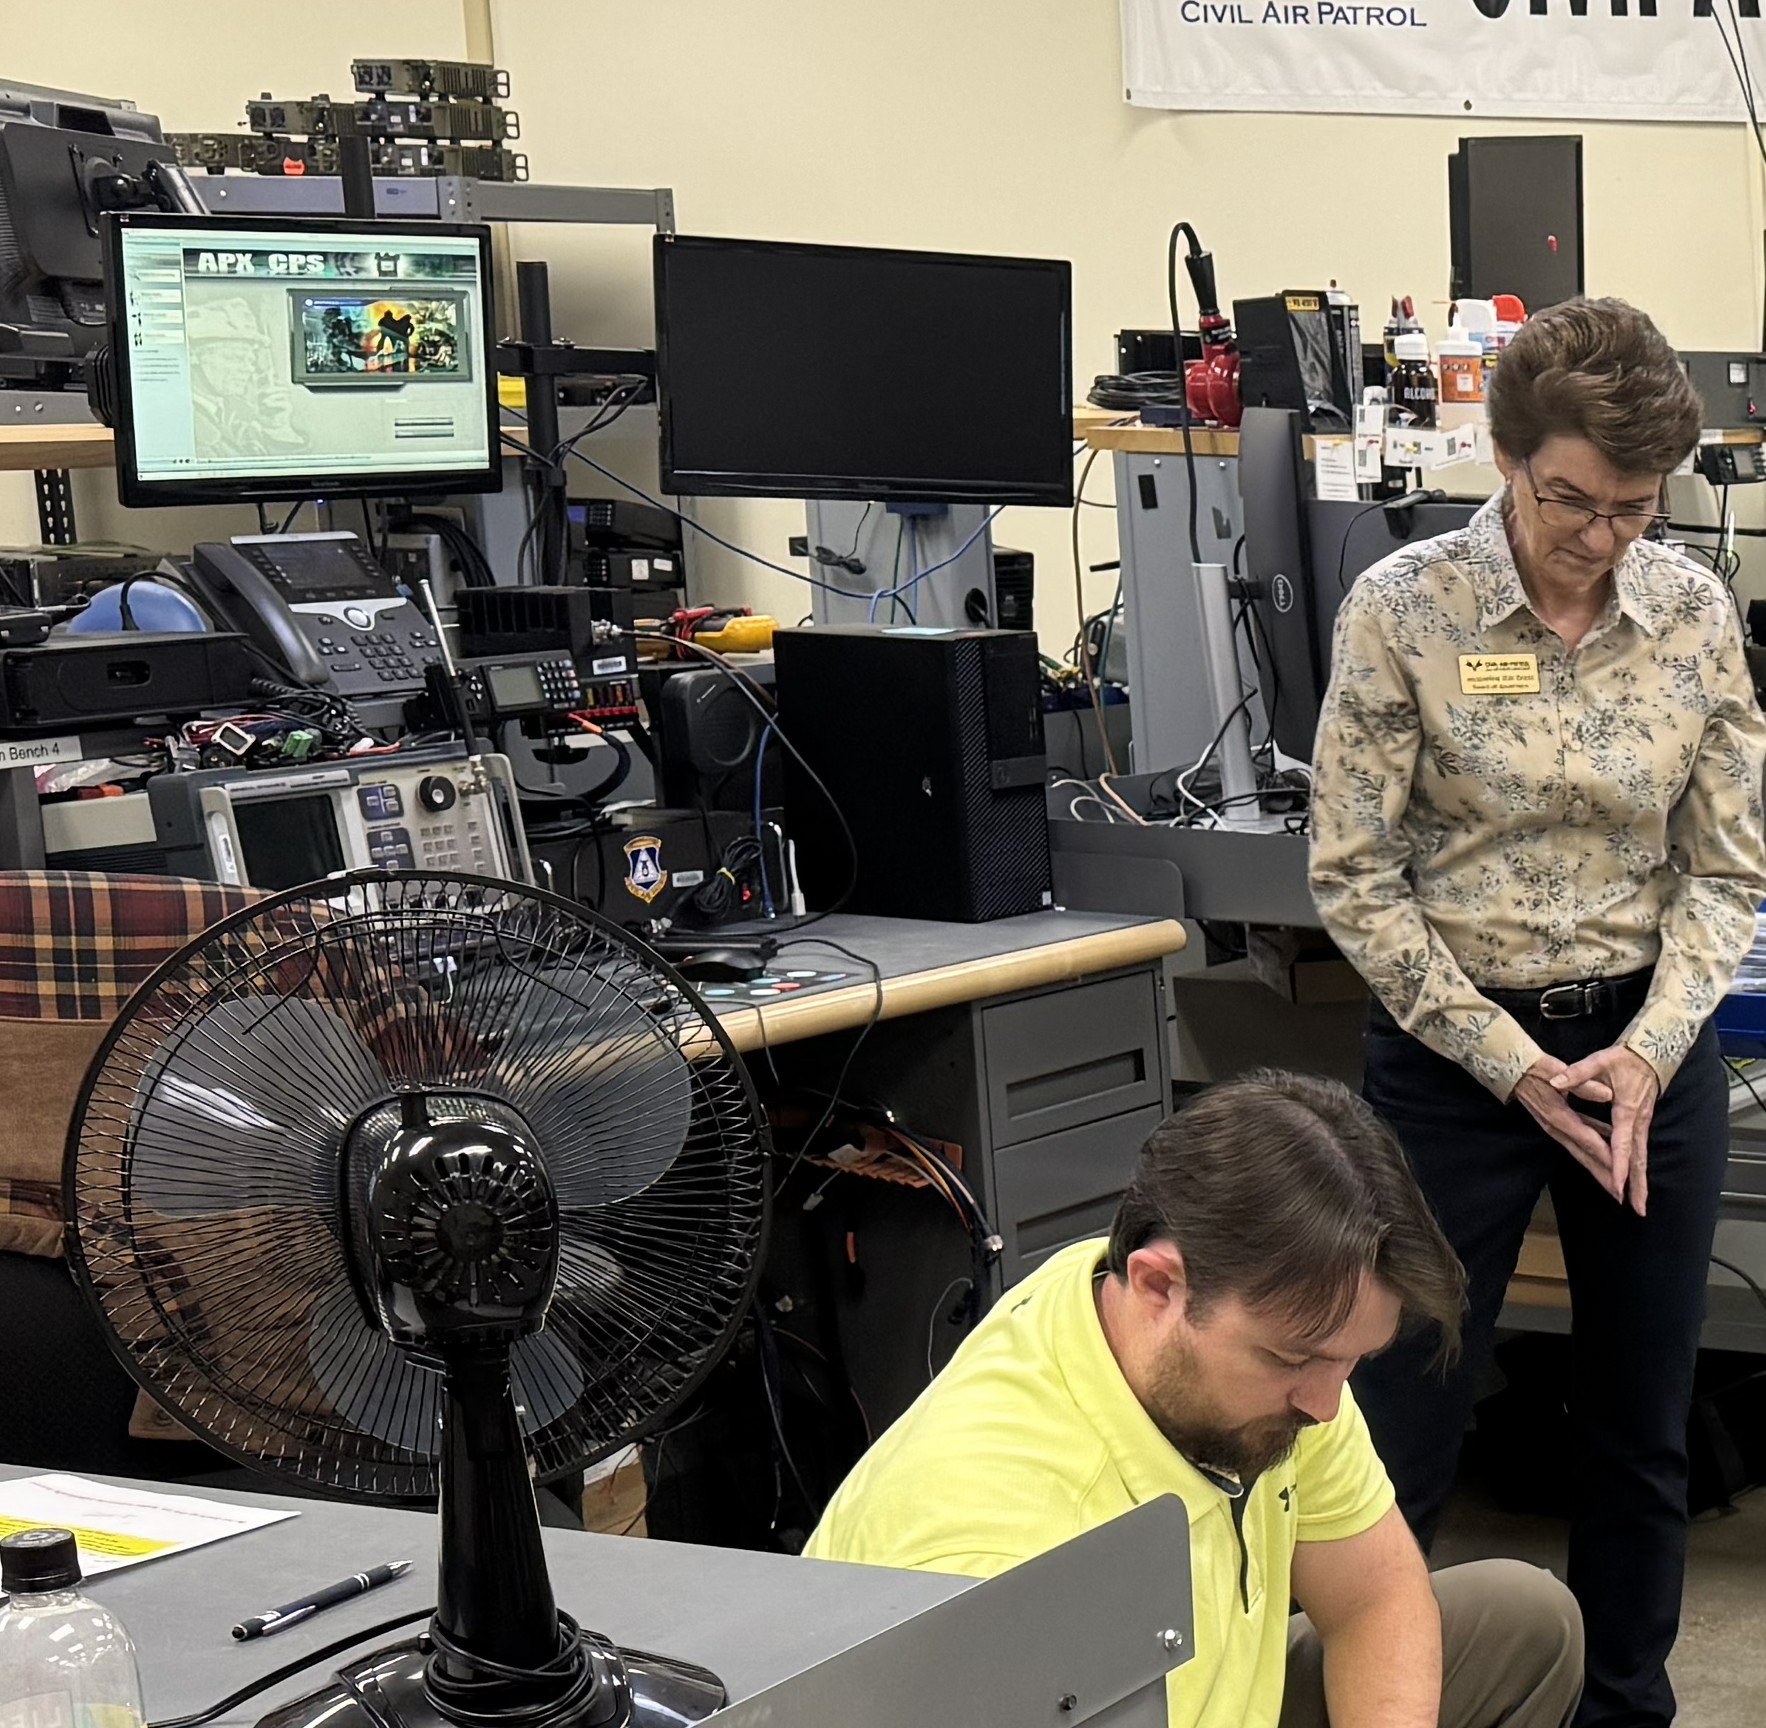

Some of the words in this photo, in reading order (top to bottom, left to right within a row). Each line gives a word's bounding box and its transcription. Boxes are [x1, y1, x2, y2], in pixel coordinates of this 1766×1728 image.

[1180, 1, 1253, 24] CIVIL
[1262, 0, 1309, 25] AIR
[1317, 3, 1427, 27] PATROL
[198, 252, 255, 273] APX
[267, 253, 325, 274] CPS
[9, 744, 48, 761] Bench
[52, 742, 60, 755] 4
